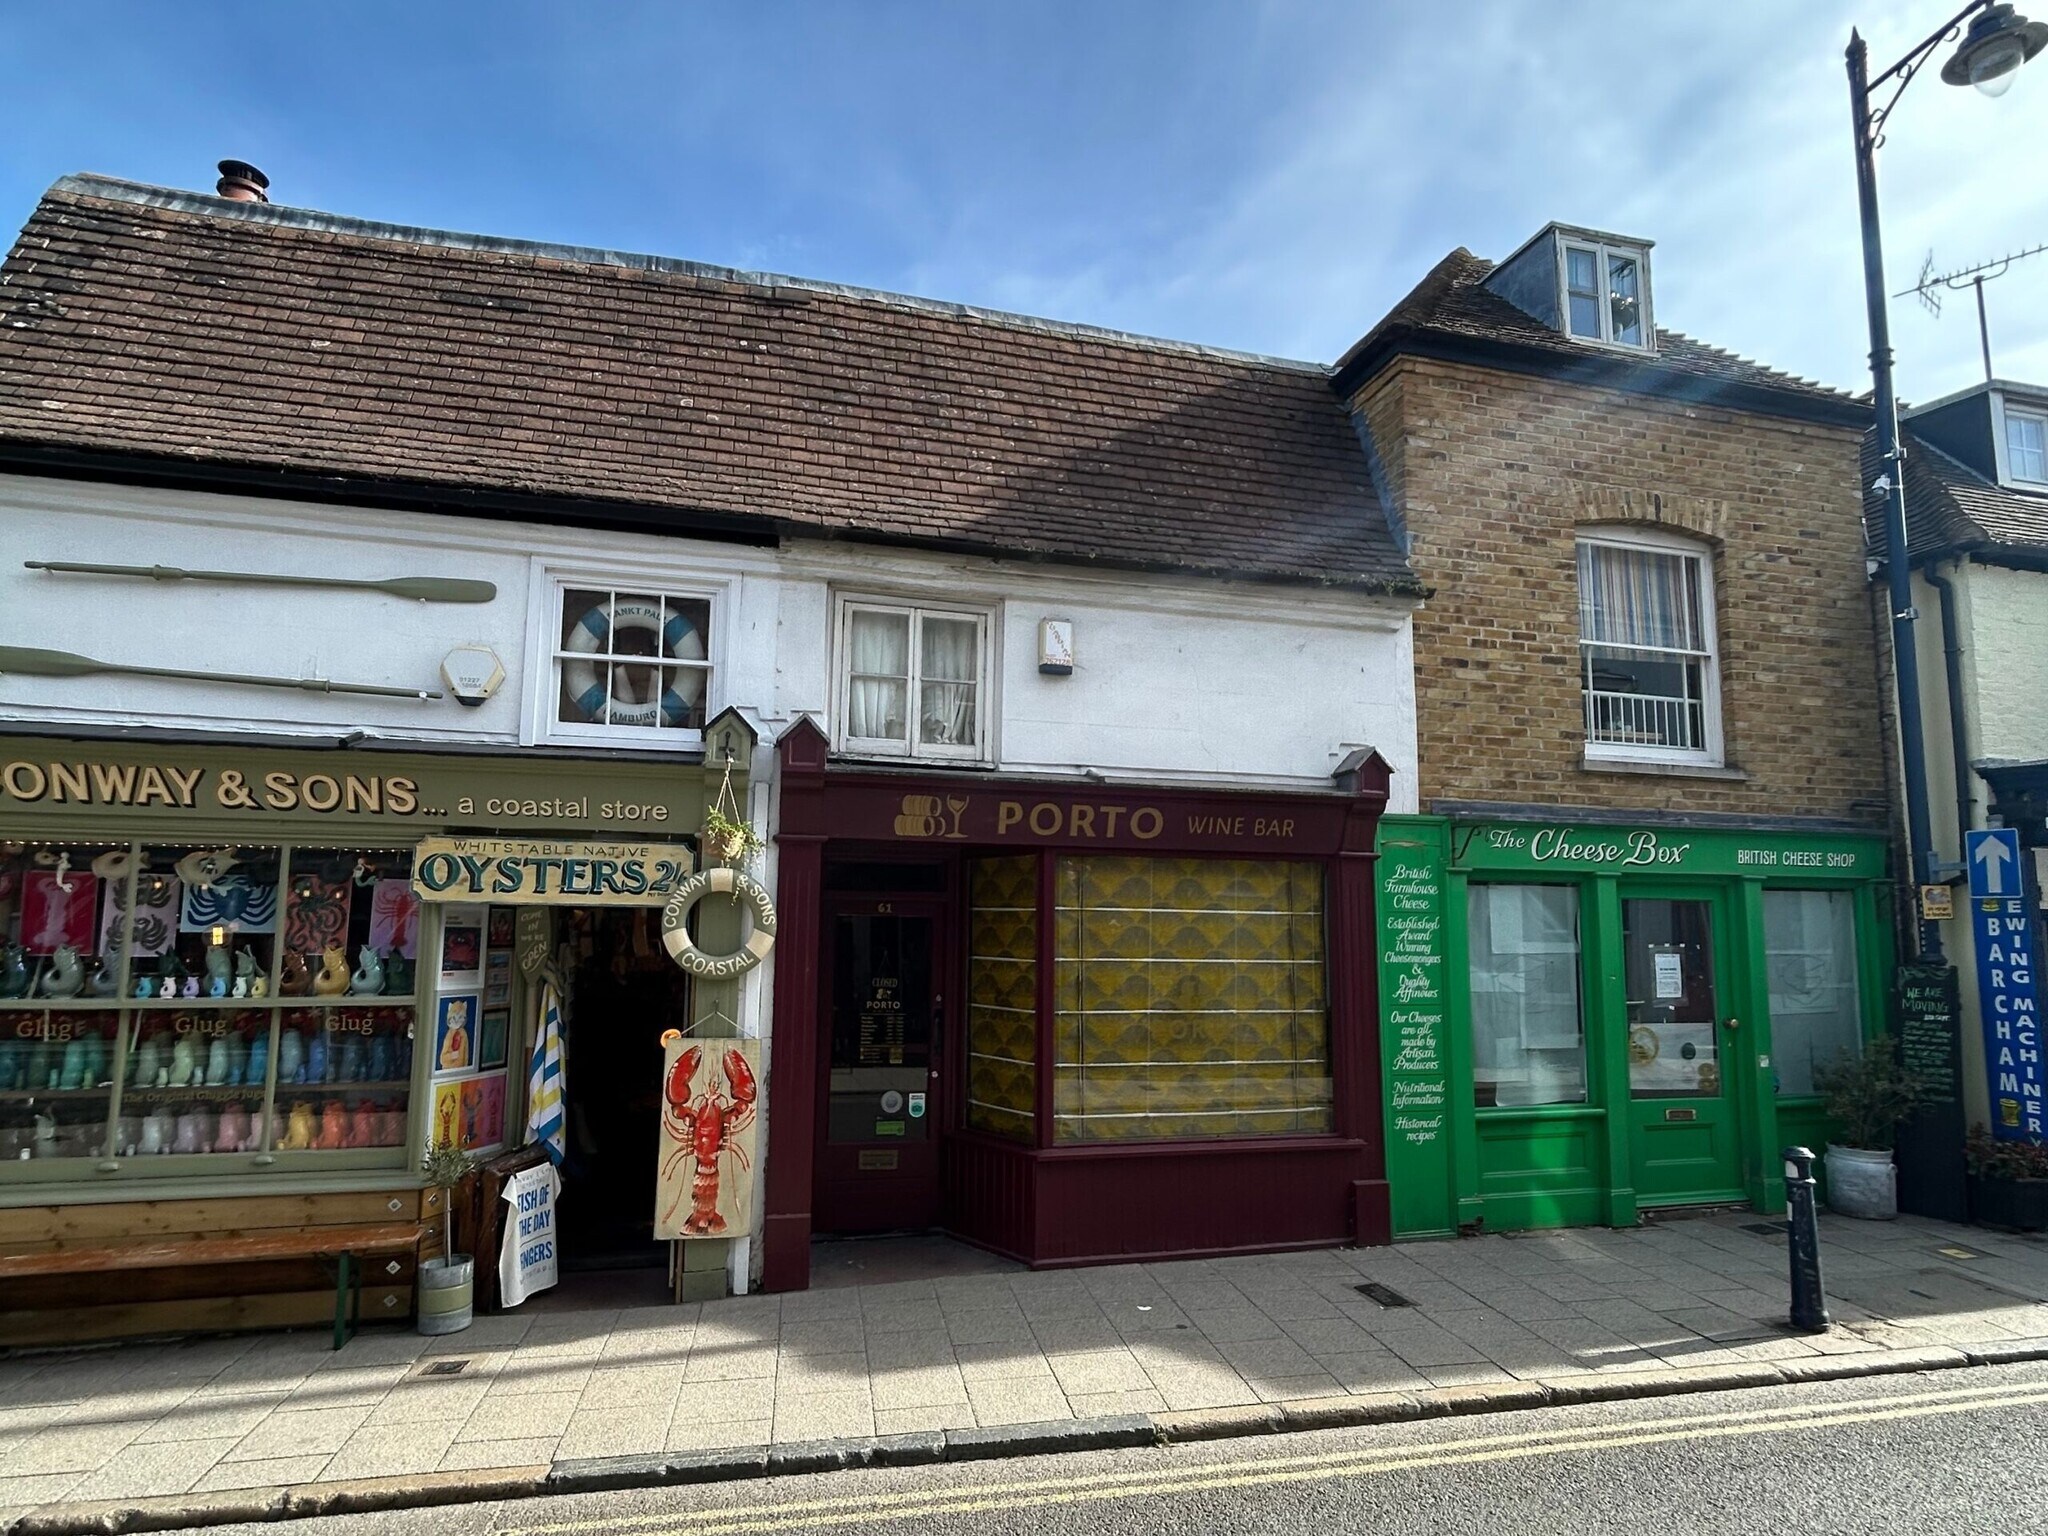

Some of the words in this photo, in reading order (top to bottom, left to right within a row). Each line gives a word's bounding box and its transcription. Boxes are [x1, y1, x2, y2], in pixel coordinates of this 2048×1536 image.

[0, 761, 206, 808] ONWAY
[217, 769, 266, 811] &
[457, 796, 475, 815] a
[486, 796, 589, 818] coastal
[600, 800, 669, 821] store
[997, 801, 1164, 839] PORTO
[1187, 815, 1246, 836] WINE
[1253, 818, 1295, 838] BAR
[453, 841, 574, 855] WHITSTABLE
[583, 845, 649, 857] NATIVE
[1489, 828, 1527, 849] The
[1530, 828, 1624, 864] Cheese
[1621, 830, 1691, 867] Box
[1737, 849, 1777, 866] BRITISH
[1782, 851, 1823, 867] CHEESE
[1826, 852, 1855, 868] SHOP
[418, 852, 649, 895] OYSTERS
[1392, 863, 1432, 879] British
[1384, 878, 1439, 895] Farmhouse
[663, 871, 708, 928] CONWAY
[736, 874, 749, 891] &
[750, 884, 776, 926] SONS
[1393, 894, 1431, 909] Cheese
[877, 903, 893, 914] 61
[527, 921, 540, 932] IN
[1387, 916, 1441, 930] Established
[1395, 928, 1433, 941] Award
[2004, 900, 2031, 984] EWING
[522, 940, 548, 970] OPEN
[1395, 940, 1432, 955] Winning
[681, 952, 754, 976] COASTAL
[1384, 951, 1442, 967] Cheesemongers
[1411, 963, 1424, 976] &
[1399, 974, 1431, 990] Quality
[1906, 986, 1921, 999] WE
[1924, 986, 1944, 999] ARE
[866, 1001, 901, 1009] PORTO
[1901, 998, 1949, 1014] MOVING
[1987, 917, 2019, 1093] BARCHAM
[325, 1014, 375, 1036] Glug
[1390, 1010, 1408, 1024] Our
[1408, 1011, 1442, 1025] Cheeses
[16, 1017, 72, 1042] Glug
[175, 1017, 227, 1037] Glug
[1401, 1026, 1416, 1035] are
[1417, 1023, 1432, 1037] all
[1401, 1035, 1425, 1047] made
[1426, 1034, 1437, 1049] by
[1398, 1046, 1437, 1059] Artisan
[1392, 1057, 1440, 1071] Producers
[1392, 1080, 1445, 1095] Nutritional
[1391, 1093, 1445, 1109] Information
[1394, 1115, 1442, 1130] Historical
[1406, 1130, 1438, 1146] recipes
[517, 1187, 538, 1213] FISH
[539, 1183, 550, 1207] OF
[533, 1209, 551, 1233] DAY
